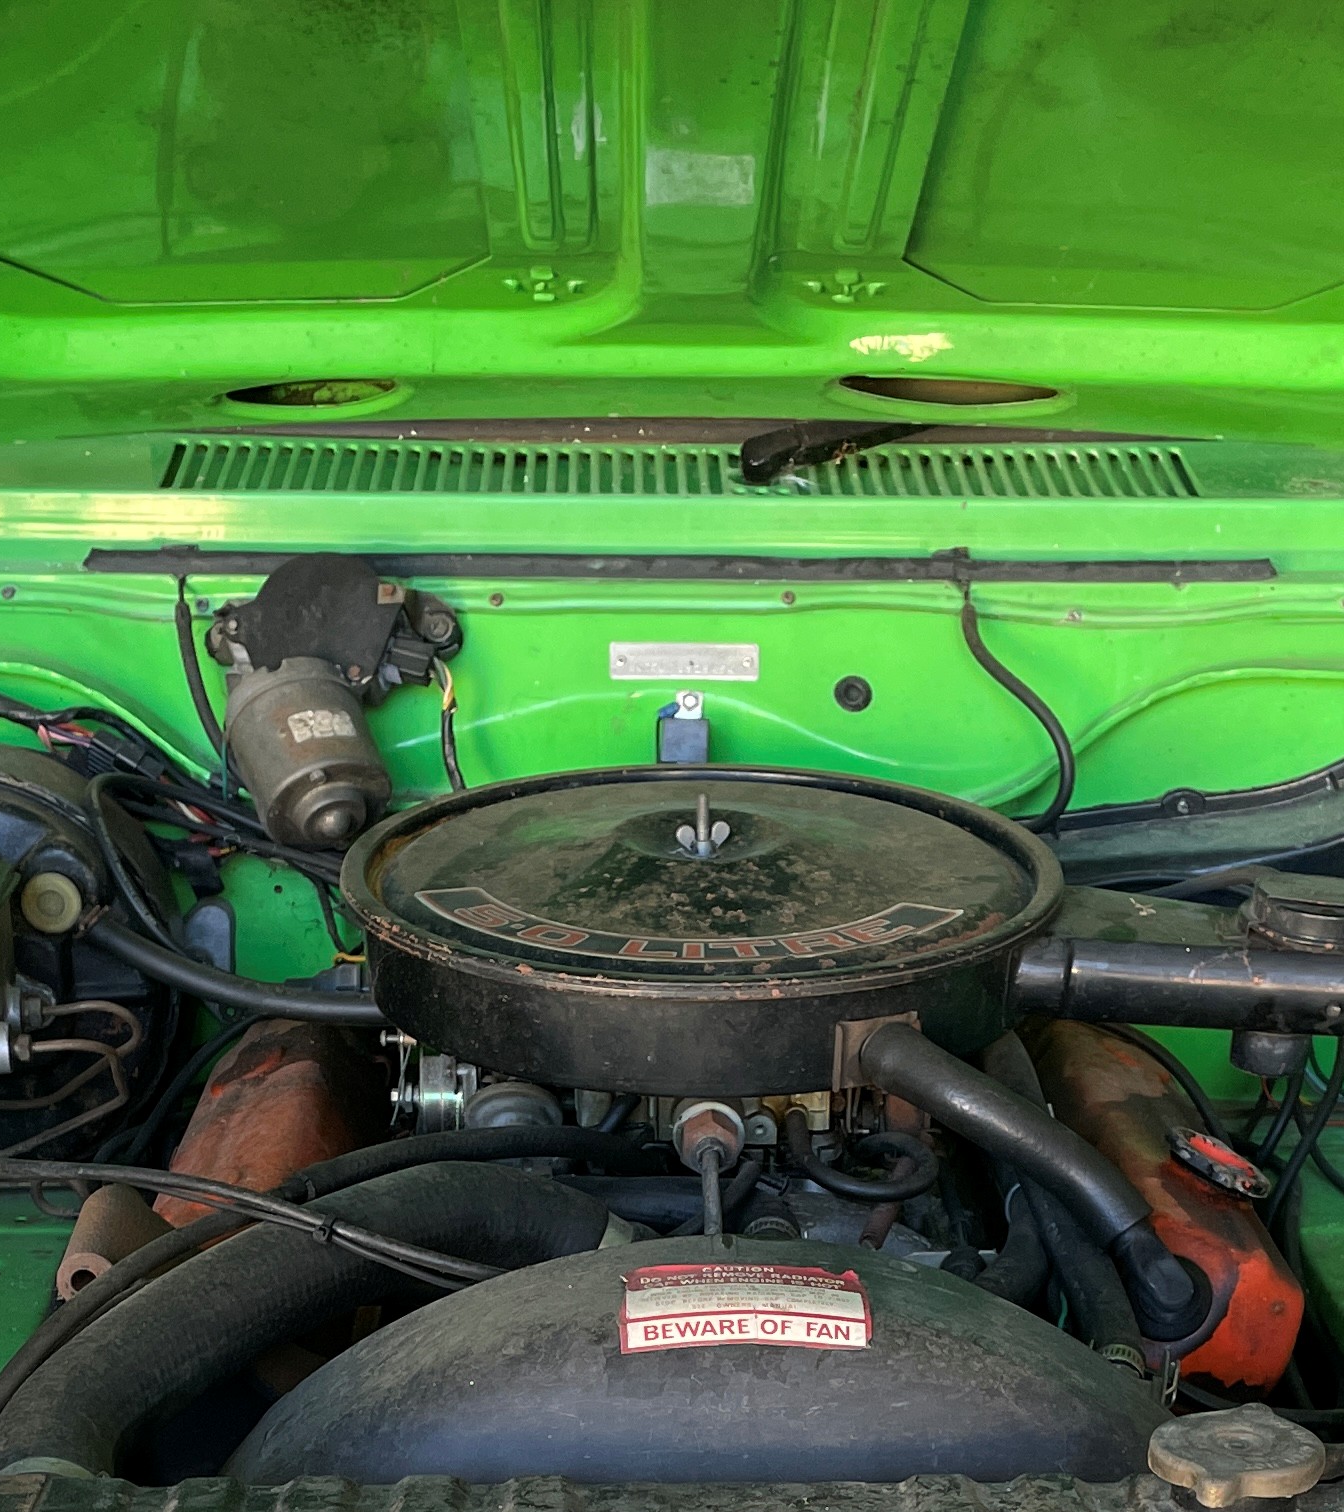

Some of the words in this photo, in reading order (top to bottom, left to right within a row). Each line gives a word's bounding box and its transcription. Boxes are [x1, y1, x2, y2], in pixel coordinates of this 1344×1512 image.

[617, 918, 916, 958] LITRE
[640, 1276, 662, 1285] DO
[770, 1273, 845, 1286] RADIATOR
[680, 1277, 725, 1285] WHEN
[811, 1281, 842, 1290] HOT
[643, 1318, 751, 1342] BEWARE
[760, 1319, 793, 1336] OF
[806, 1321, 851, 1341] FAN
